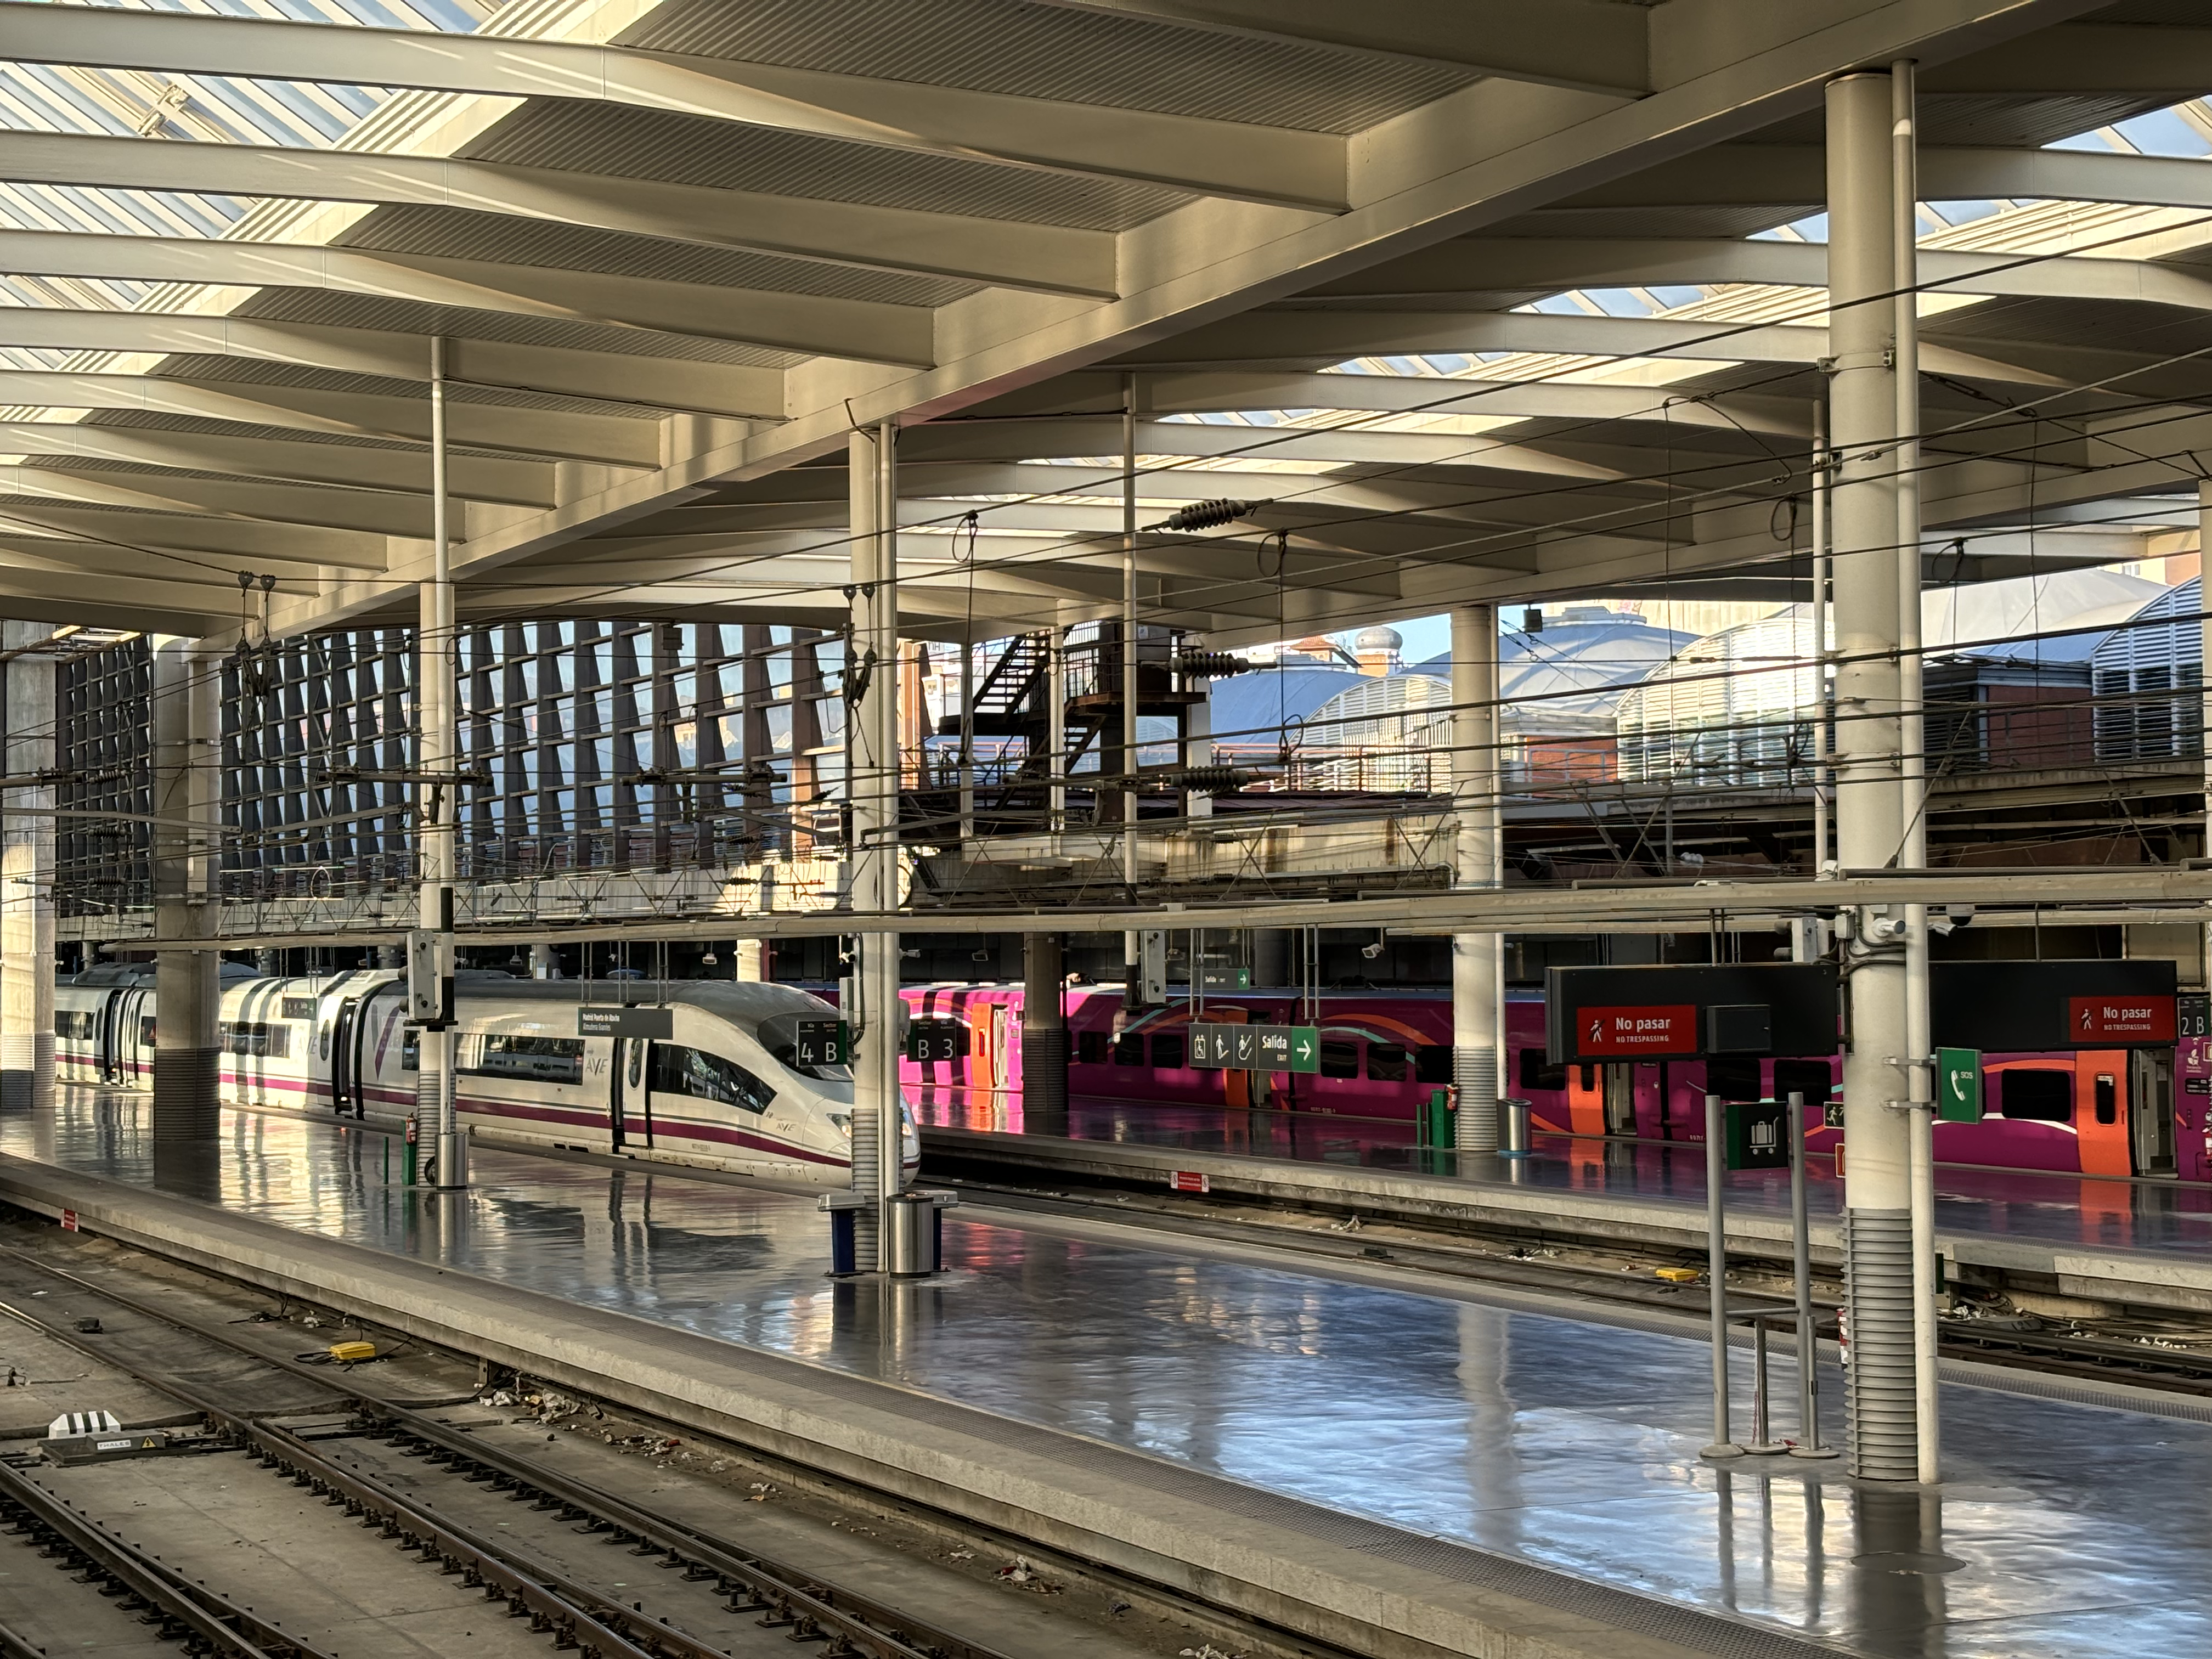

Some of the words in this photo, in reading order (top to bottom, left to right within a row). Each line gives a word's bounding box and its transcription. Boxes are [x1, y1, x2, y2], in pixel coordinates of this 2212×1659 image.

[2103, 1006, 2118, 1019] No
[2121, 1008, 2152, 1022] pasar
[1616, 1017, 1632, 1030] No
[1637, 1019, 1671, 1032] pasar
[2181, 1017, 2190, 1035] 2
[2196, 1016, 2204, 1034] B
[1262, 1034, 1287, 1049] Salida
[1626, 1035, 1669, 1043] TRESPASSING
[801, 1042, 814, 1063] 4
[826, 1042, 837, 1062] B
[918, 1039, 929, 1059] B
[943, 1039, 953, 1058] 3
[585, 1058, 608, 1076] AVE
[1960, 1071, 1973, 1079] SOS
[776, 1122, 797, 1132] AVE
